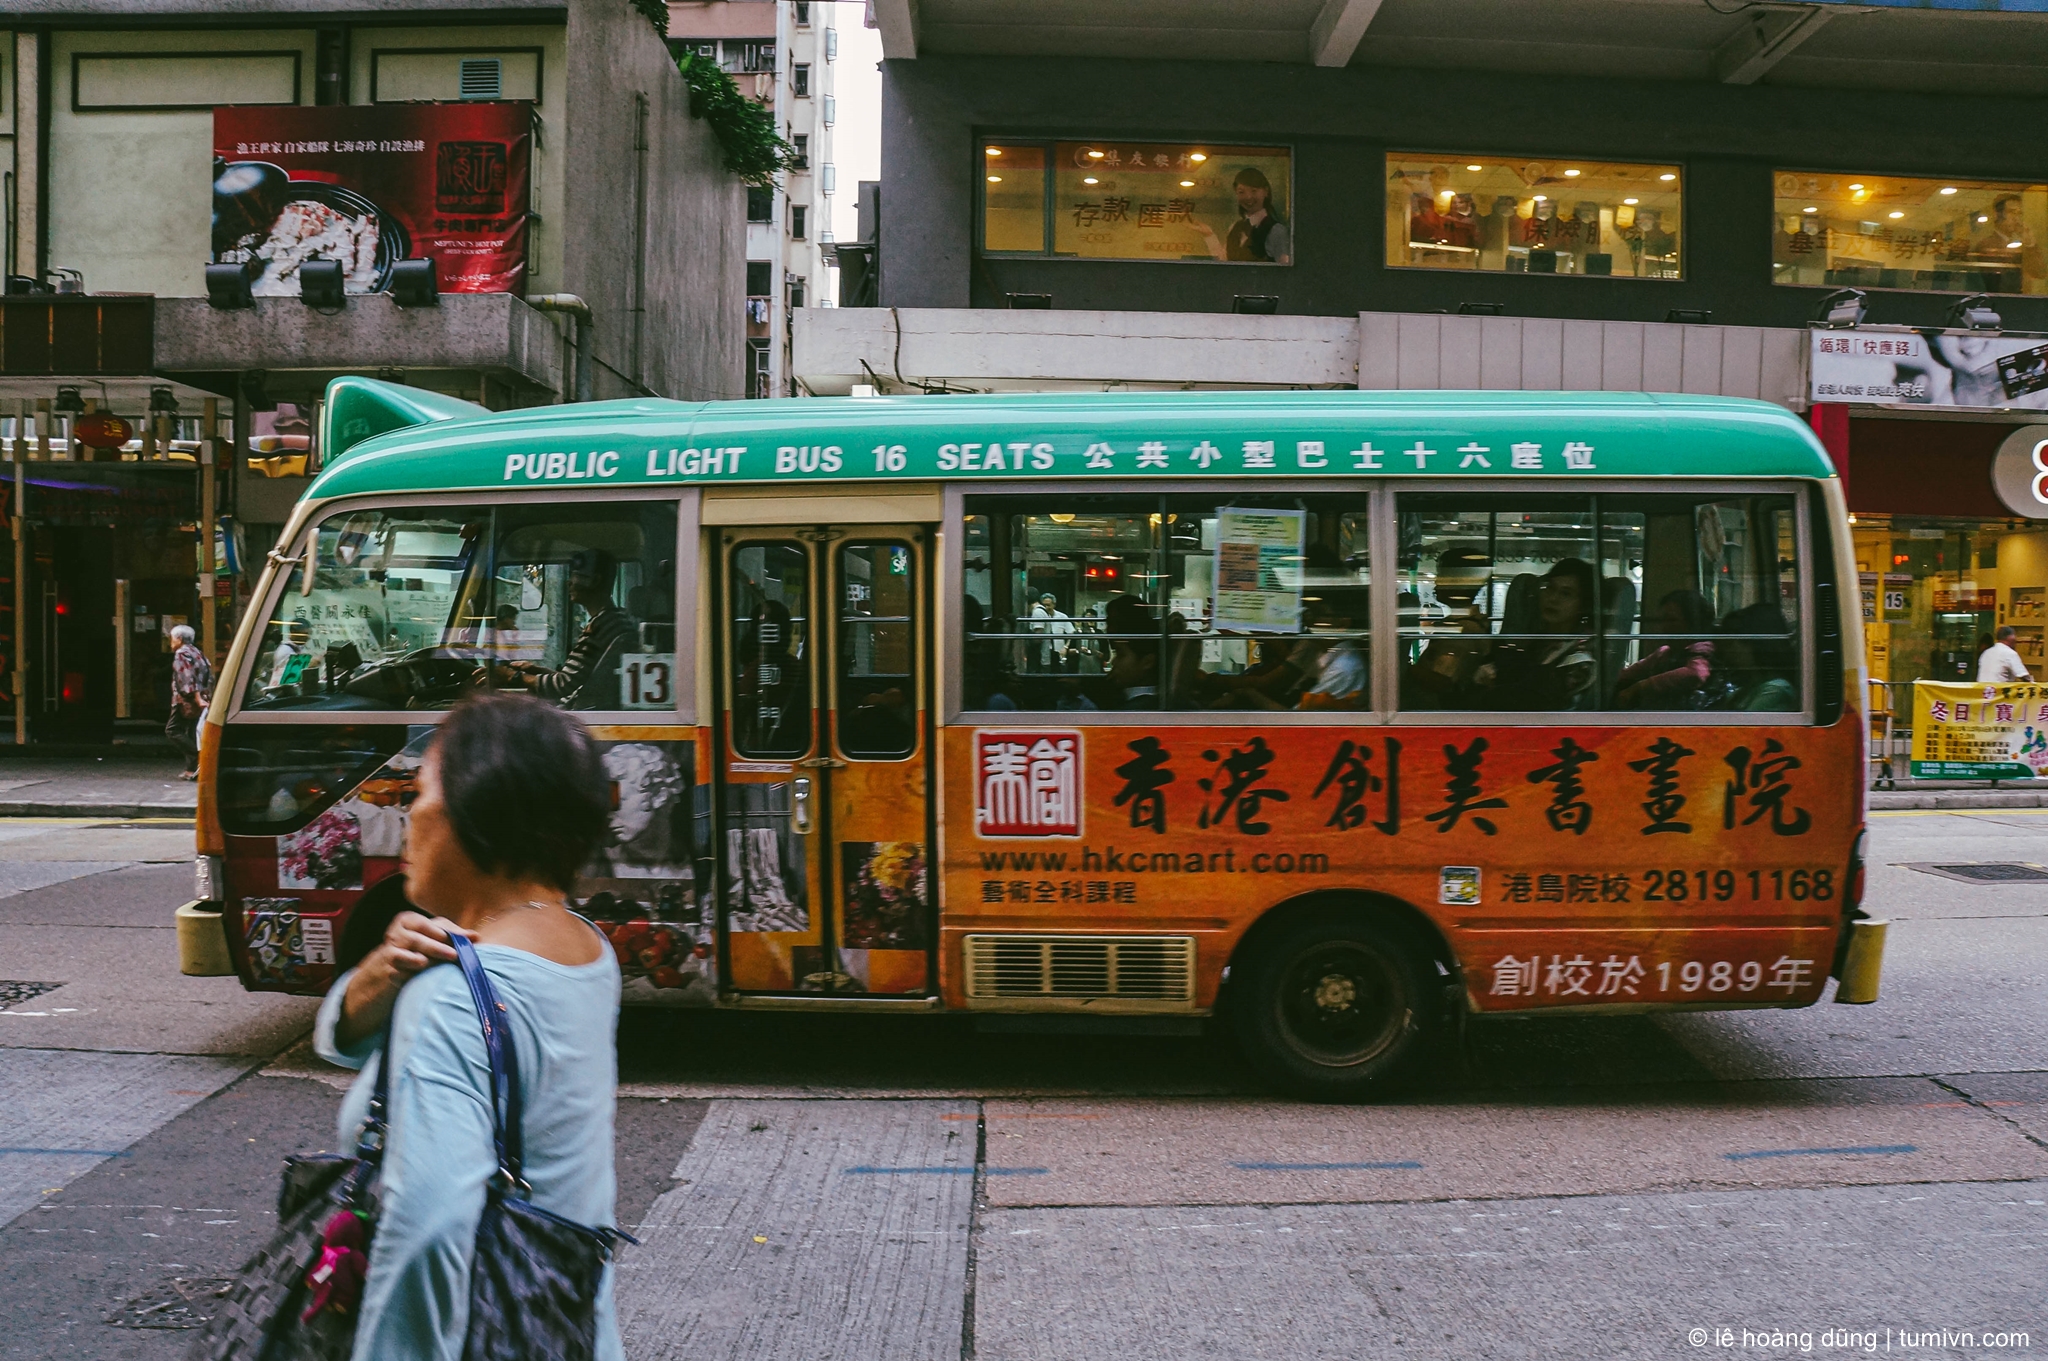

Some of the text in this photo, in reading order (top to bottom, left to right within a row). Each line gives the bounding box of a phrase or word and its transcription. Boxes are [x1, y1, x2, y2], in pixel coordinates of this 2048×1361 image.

[1073, 196, 1196, 229] 存款 匯款
[503, 442, 1056, 481] PUBLIC LIGHT BUS 16 SEATS
[1082, 440, 1598, 470] 公共小型巴士十六座位
[626, 662, 669, 704] 13
[758, 621, 781, 728] 自動門
[1112, 736, 1812, 836] 香港創美書畫院
[980, 846, 1330, 873] www.hkcmart.com
[981, 880, 1138, 904] 藝術全科課程
[1500, 869, 1835, 903] 港島院校 2819 1168
[1488, 954, 1816, 997] 創校於1989年
